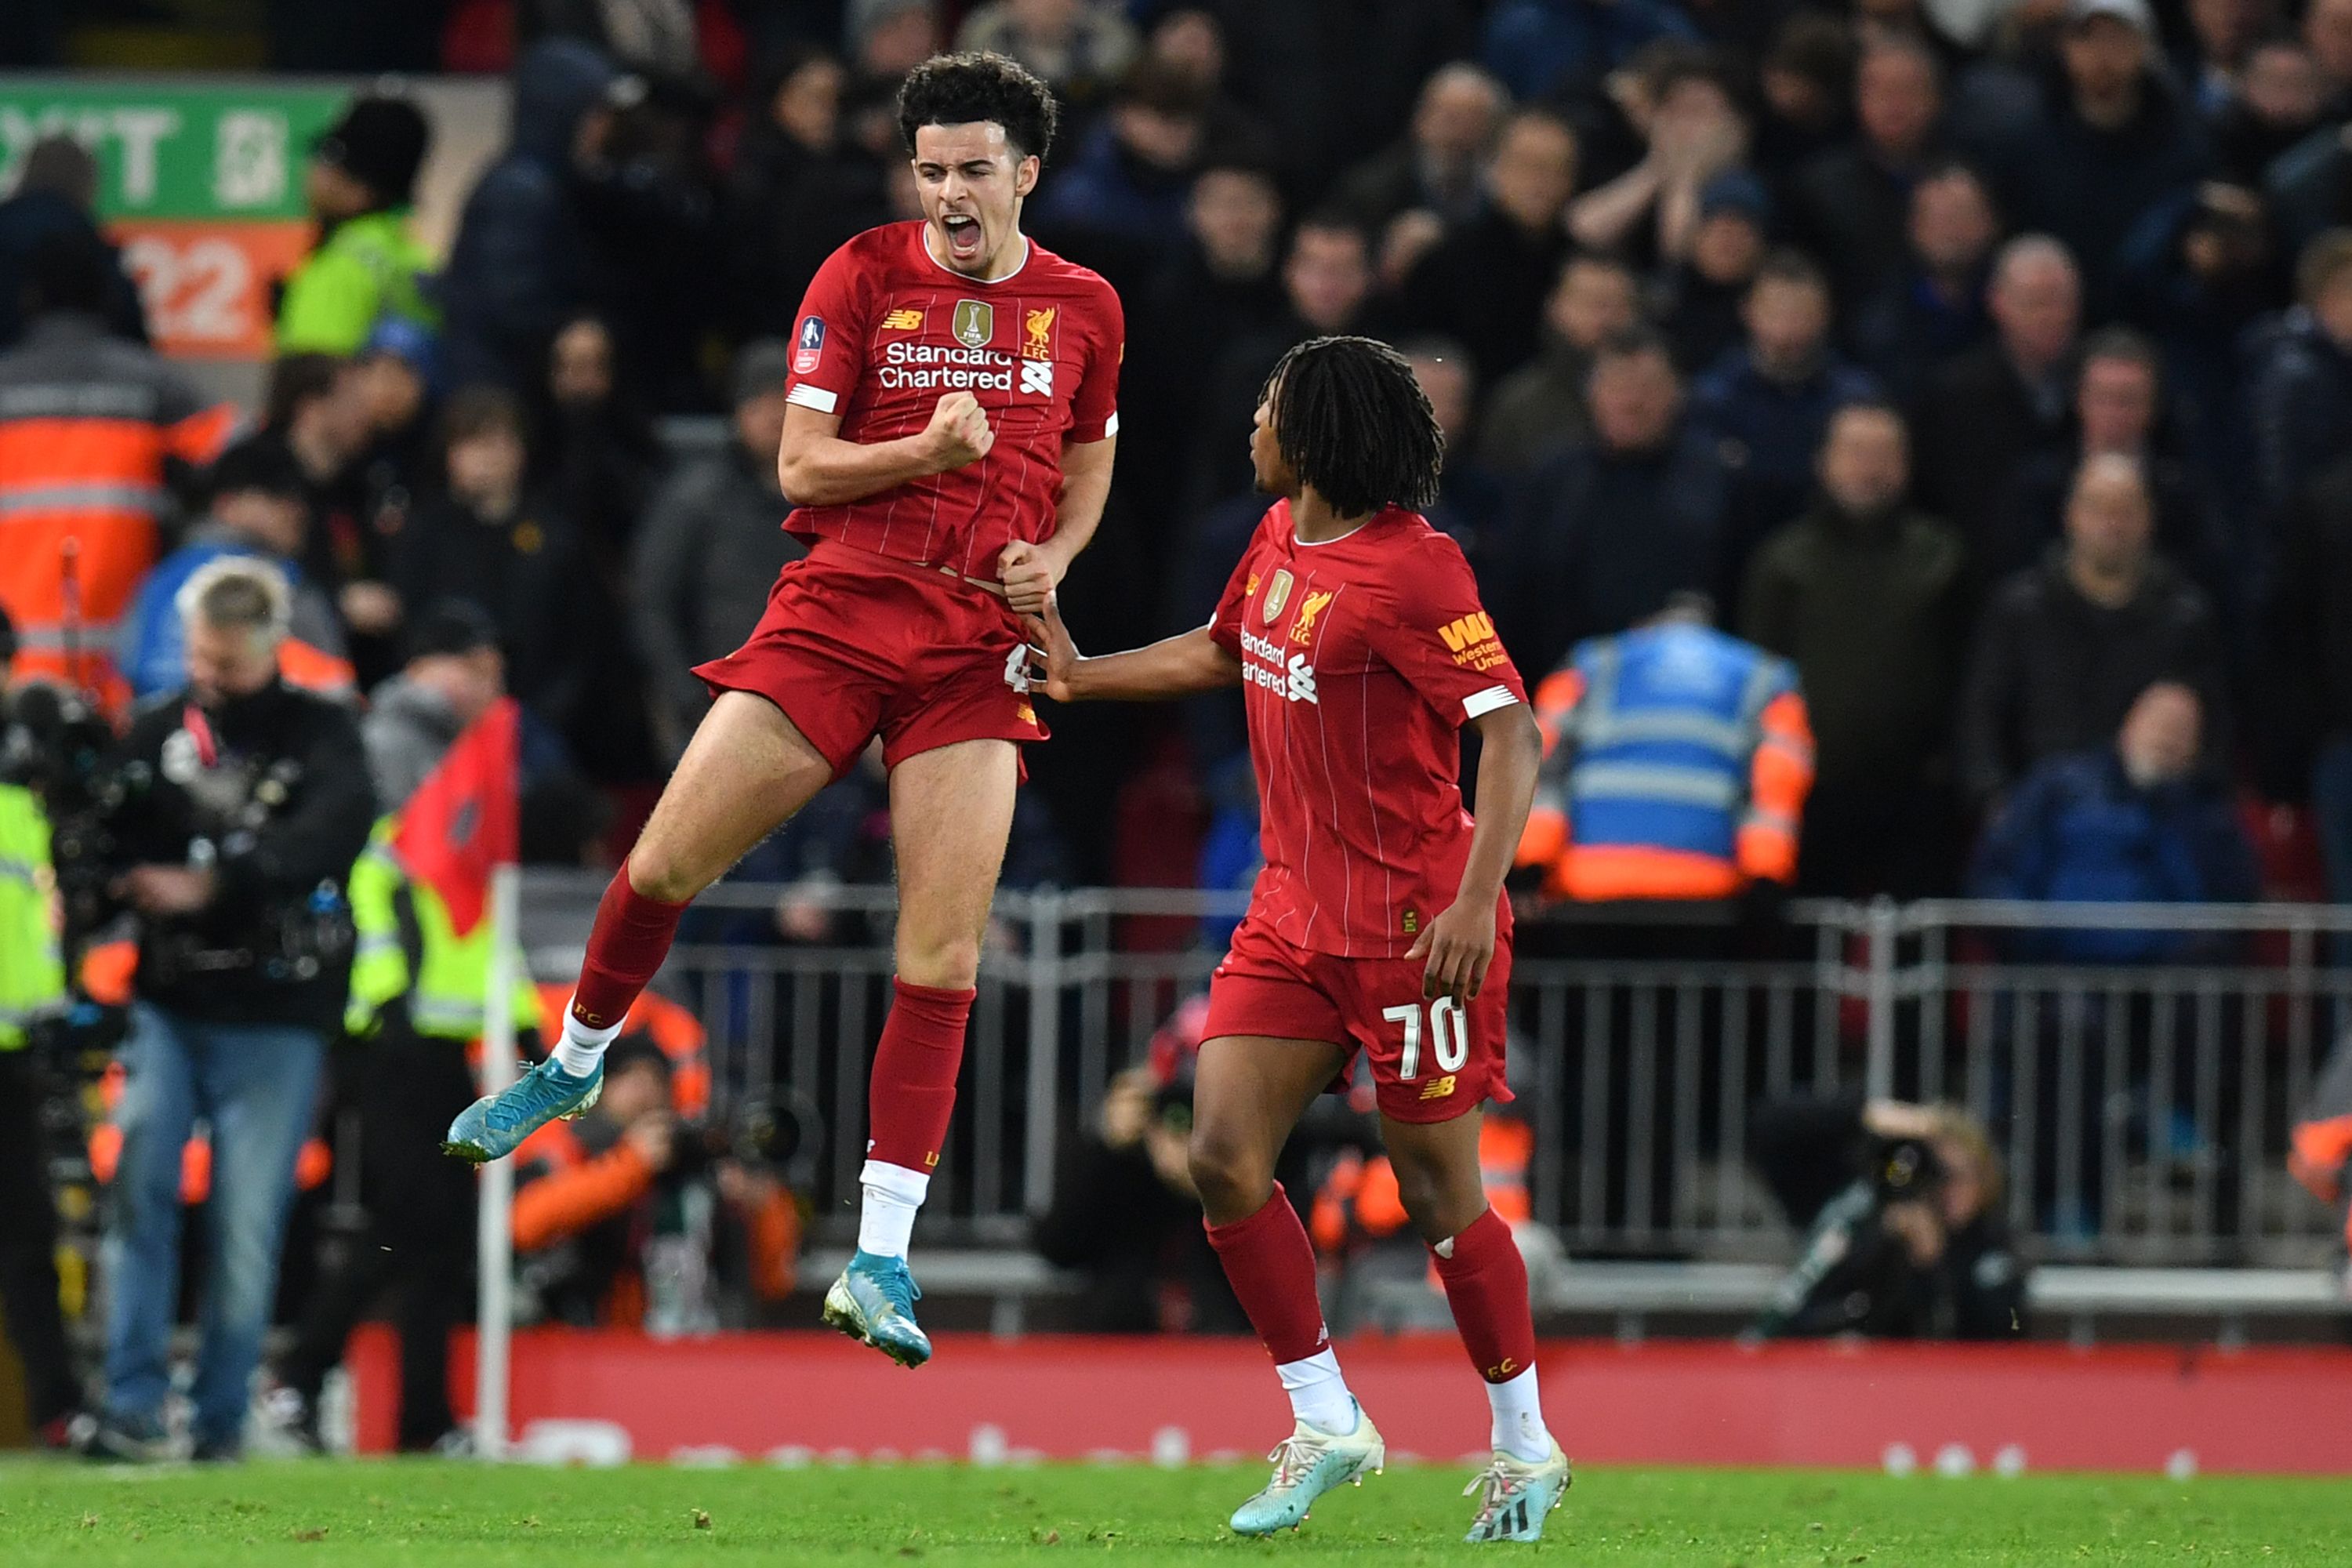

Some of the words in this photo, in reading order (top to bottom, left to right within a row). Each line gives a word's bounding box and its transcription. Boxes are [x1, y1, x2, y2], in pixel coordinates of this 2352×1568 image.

[886, 342, 1013, 366] Standard
[879, 365, 1013, 390] Chartered
[1382, 996, 1469, 1080] 70
